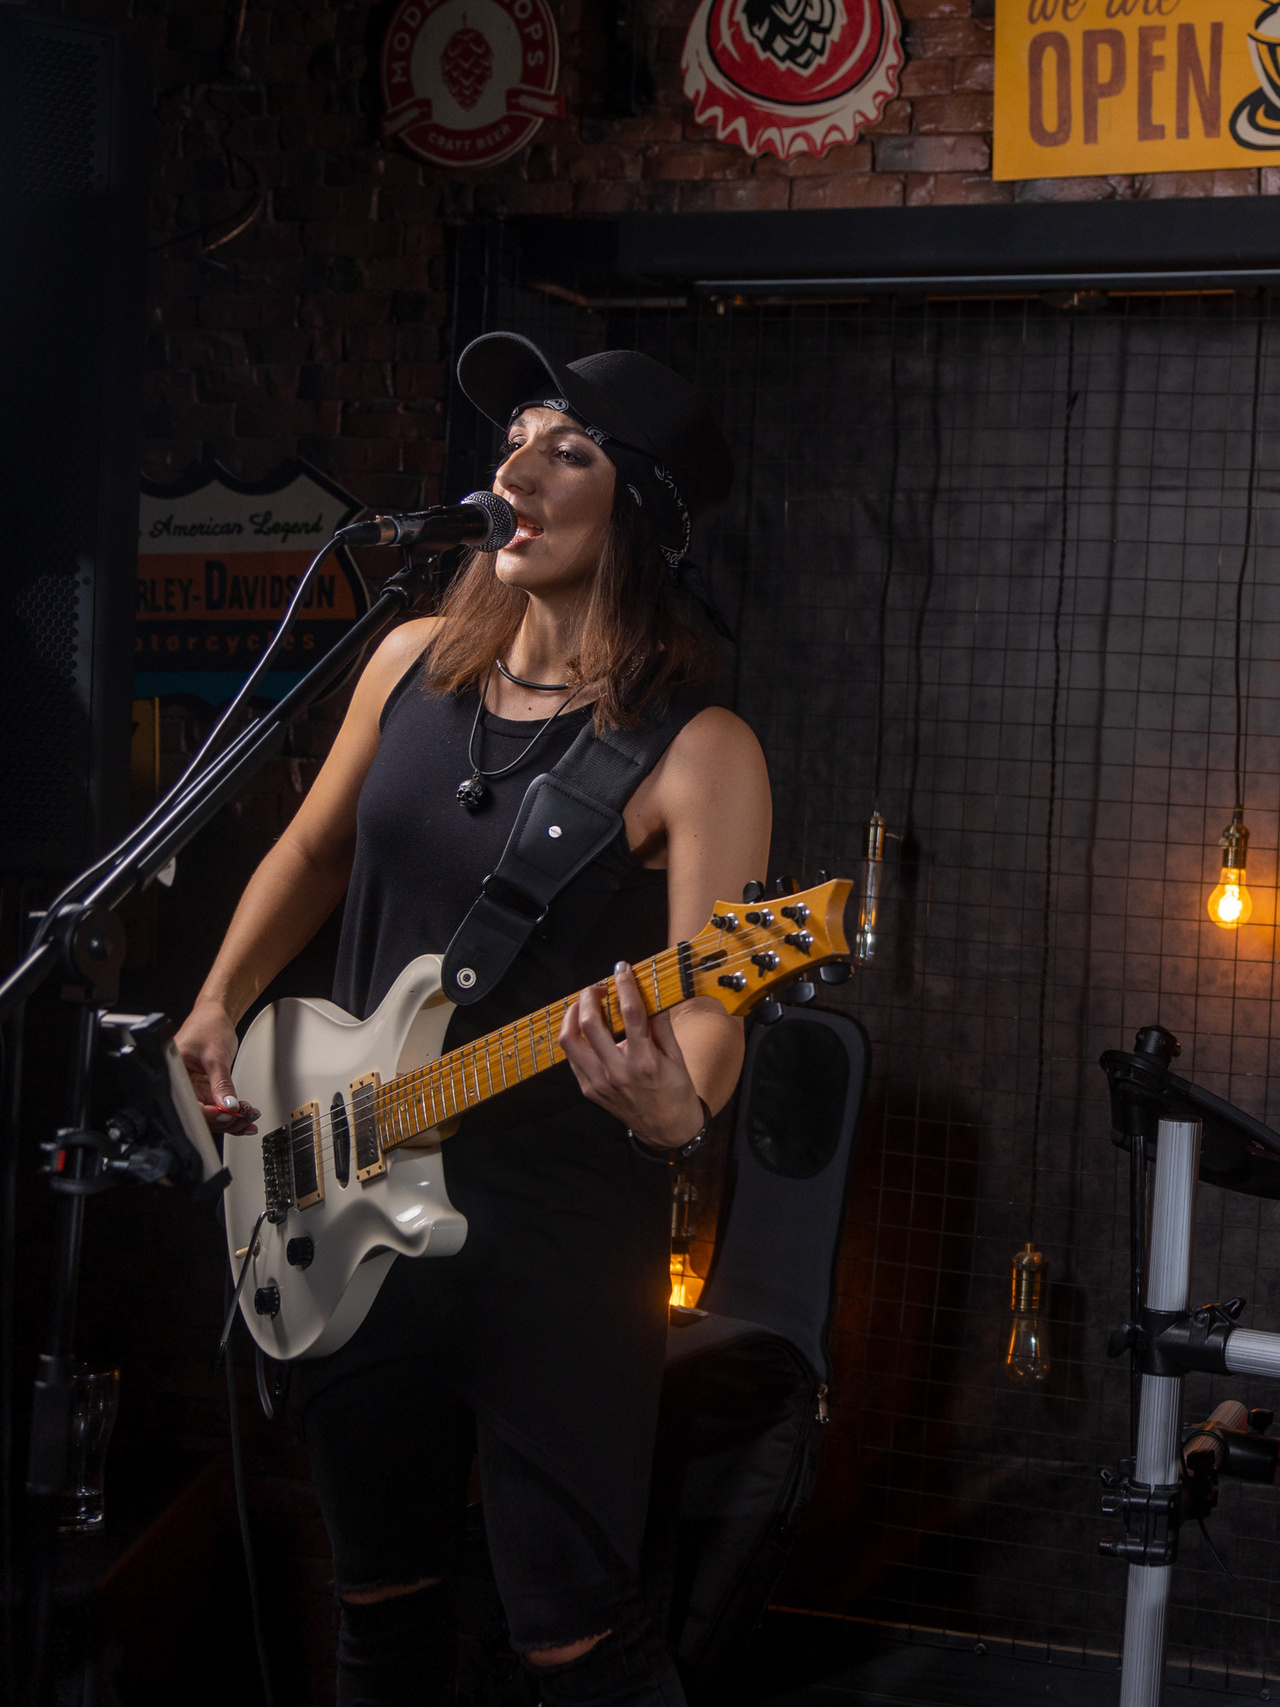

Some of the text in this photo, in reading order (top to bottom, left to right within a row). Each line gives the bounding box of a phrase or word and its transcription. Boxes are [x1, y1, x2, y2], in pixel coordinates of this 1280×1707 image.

[502, 0, 545, 67] OPS
[1028, 21, 1224, 147] OPEN
[428, 123, 511, 152] CRAFT BEER
[150, 511, 323, 543] American Legend
